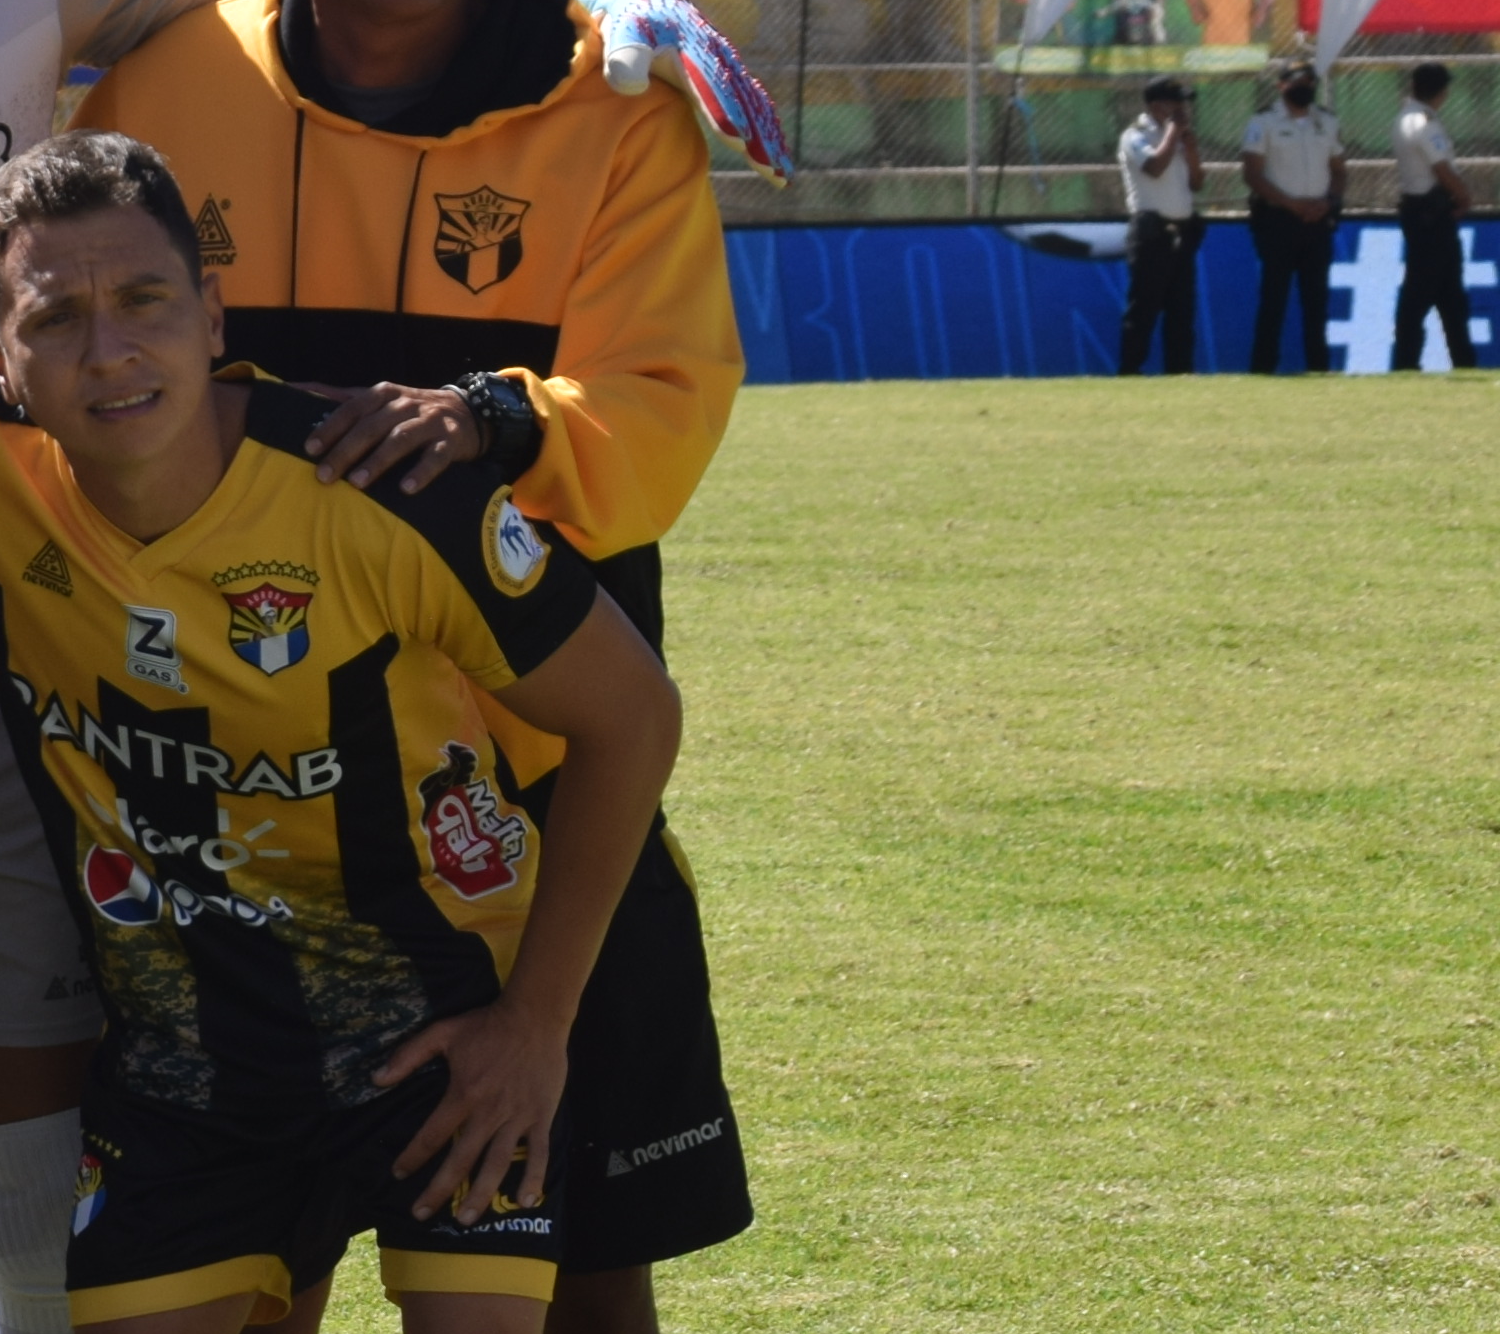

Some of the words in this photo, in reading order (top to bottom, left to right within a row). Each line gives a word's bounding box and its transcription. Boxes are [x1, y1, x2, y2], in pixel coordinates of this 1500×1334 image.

[129, 611, 175, 660] Z
[135, 663, 172, 683] GAS
[466, 777, 527, 865] Malta
[632, 1117, 724, 1167] nevimar
